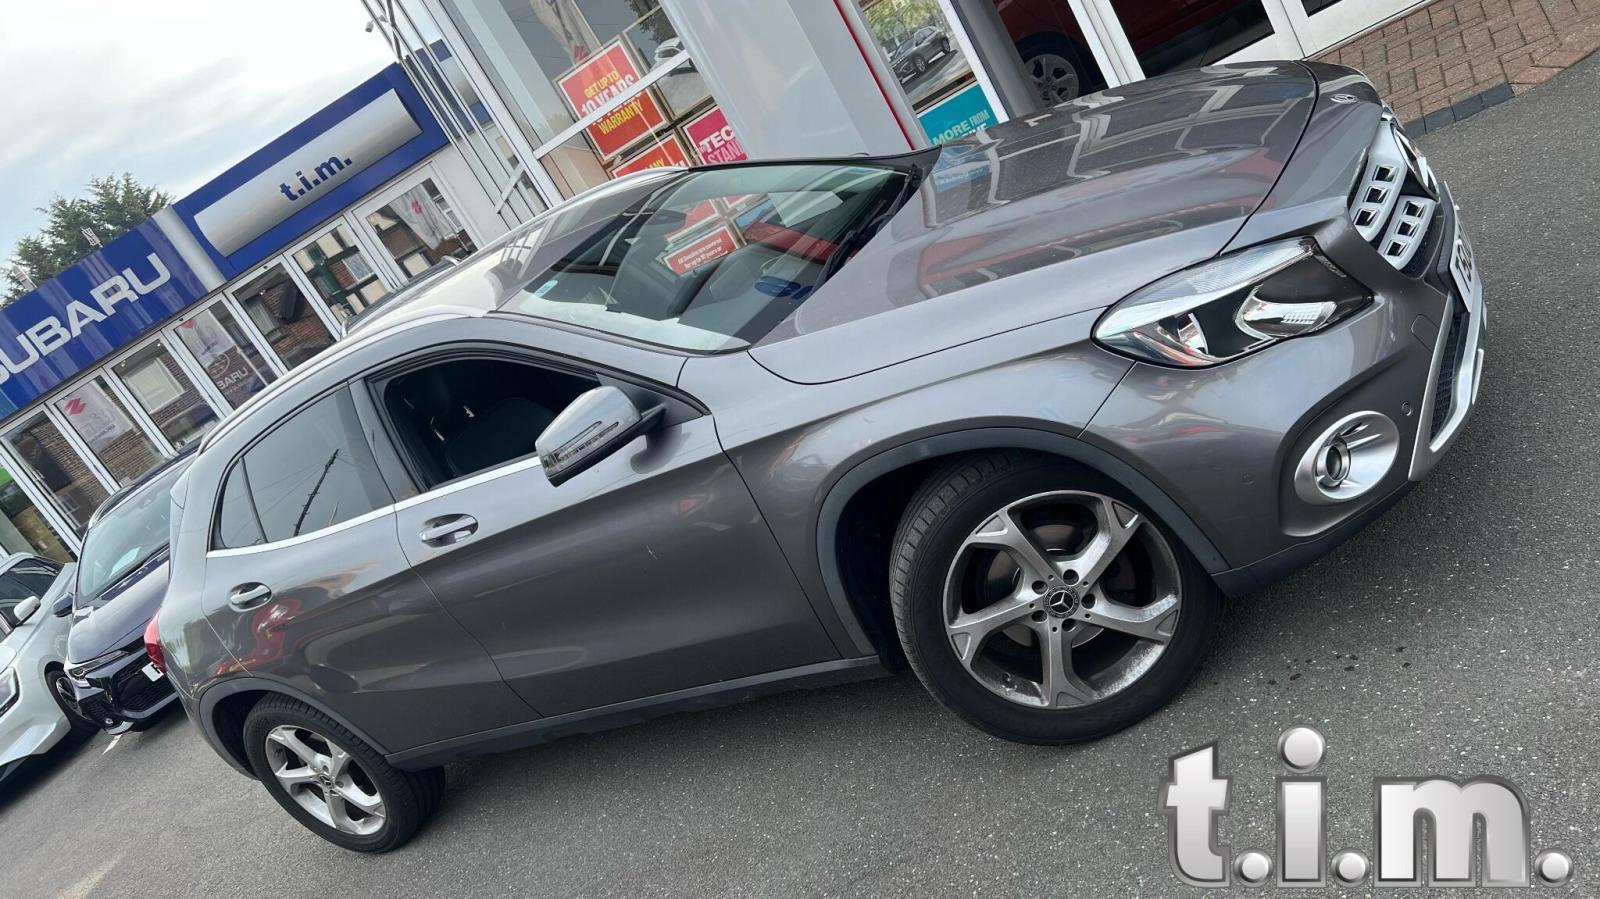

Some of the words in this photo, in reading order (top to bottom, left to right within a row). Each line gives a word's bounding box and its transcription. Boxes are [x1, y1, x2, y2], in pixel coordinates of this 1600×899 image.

[584, 82, 600, 98] GET
[597, 76, 609, 92] UP
[607, 70, 620, 84] TO
[597, 99, 643, 135] WARRANTY
[932, 120, 970, 145] MORE
[969, 109, 990, 127] FROM
[708, 138, 745, 164] STAN
[280, 157, 353, 201] t.i.m.
